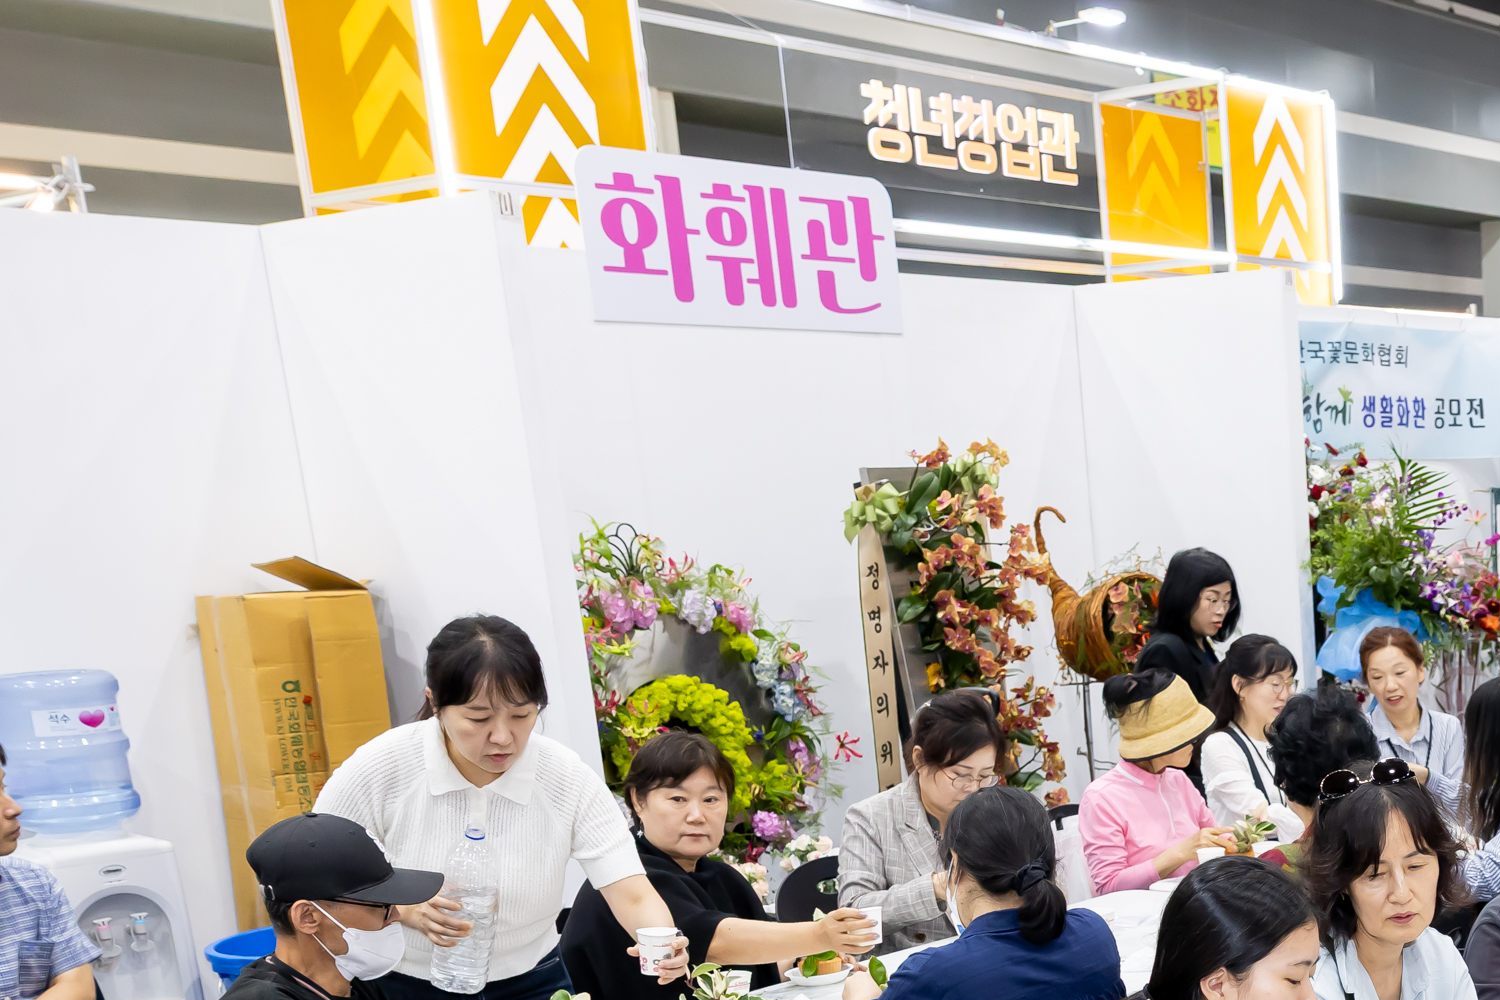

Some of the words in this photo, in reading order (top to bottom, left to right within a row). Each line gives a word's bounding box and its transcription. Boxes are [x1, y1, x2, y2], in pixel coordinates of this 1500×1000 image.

[860, 79, 1081, 187] 청년창업관
[594, 171, 885, 315] 화훼관
[1299, 340, 1409, 368] 국꽃문화협회
[1361, 394, 1427, 428] 생활화환
[1434, 397, 1487, 429] 공모전
